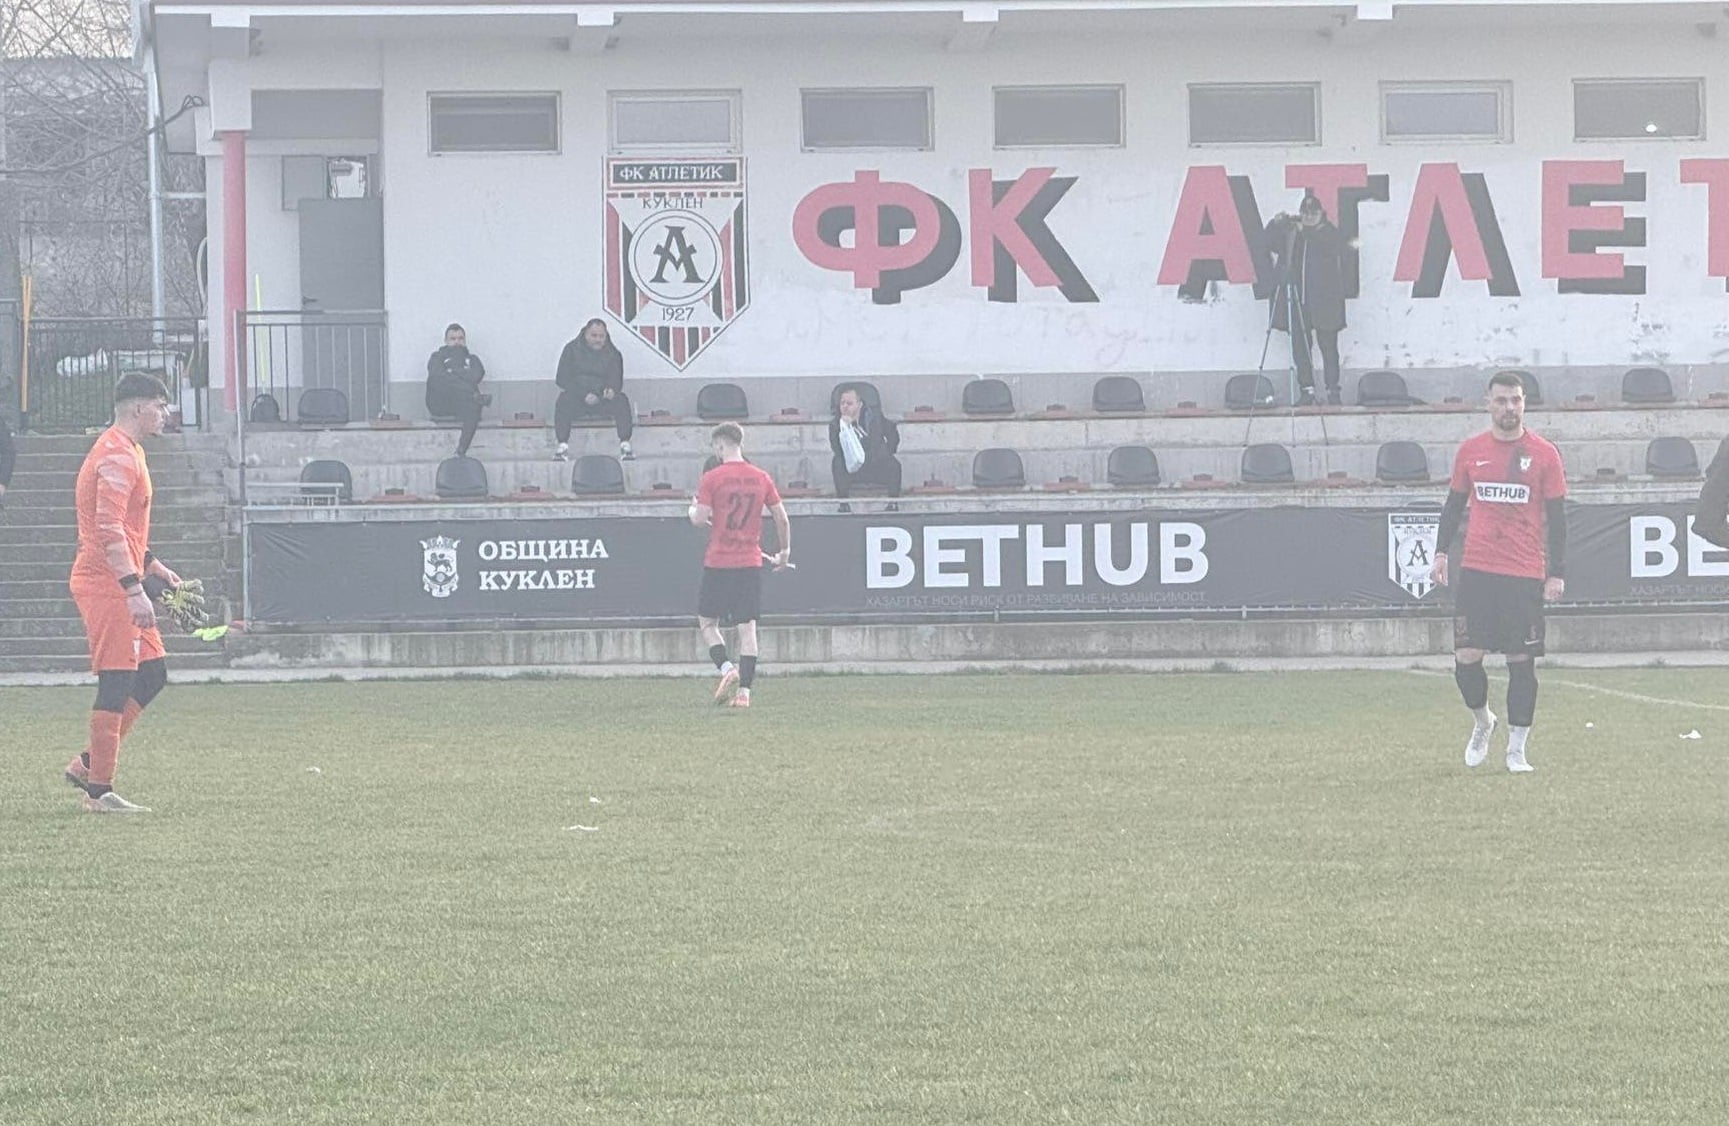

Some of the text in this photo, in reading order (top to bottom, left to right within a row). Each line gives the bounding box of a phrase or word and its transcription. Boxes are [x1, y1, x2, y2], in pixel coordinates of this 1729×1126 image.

[620, 165, 724, 181] ФК АТЛЕТИК
[642, 198, 704, 209] КУКЛЕН
[792, 167, 1100, 304] ФК
[662, 307, 695, 322] 1927
[1477, 486, 1526, 499] BETHUB
[726, 492, 755, 530] 27
[478, 539, 609, 563] ОБЩИНА
[866, 522, 1209, 588] BETHUB
[479, 569, 596, 590] КУКЛЕН
[970, 594, 1005, 605] РИСК
